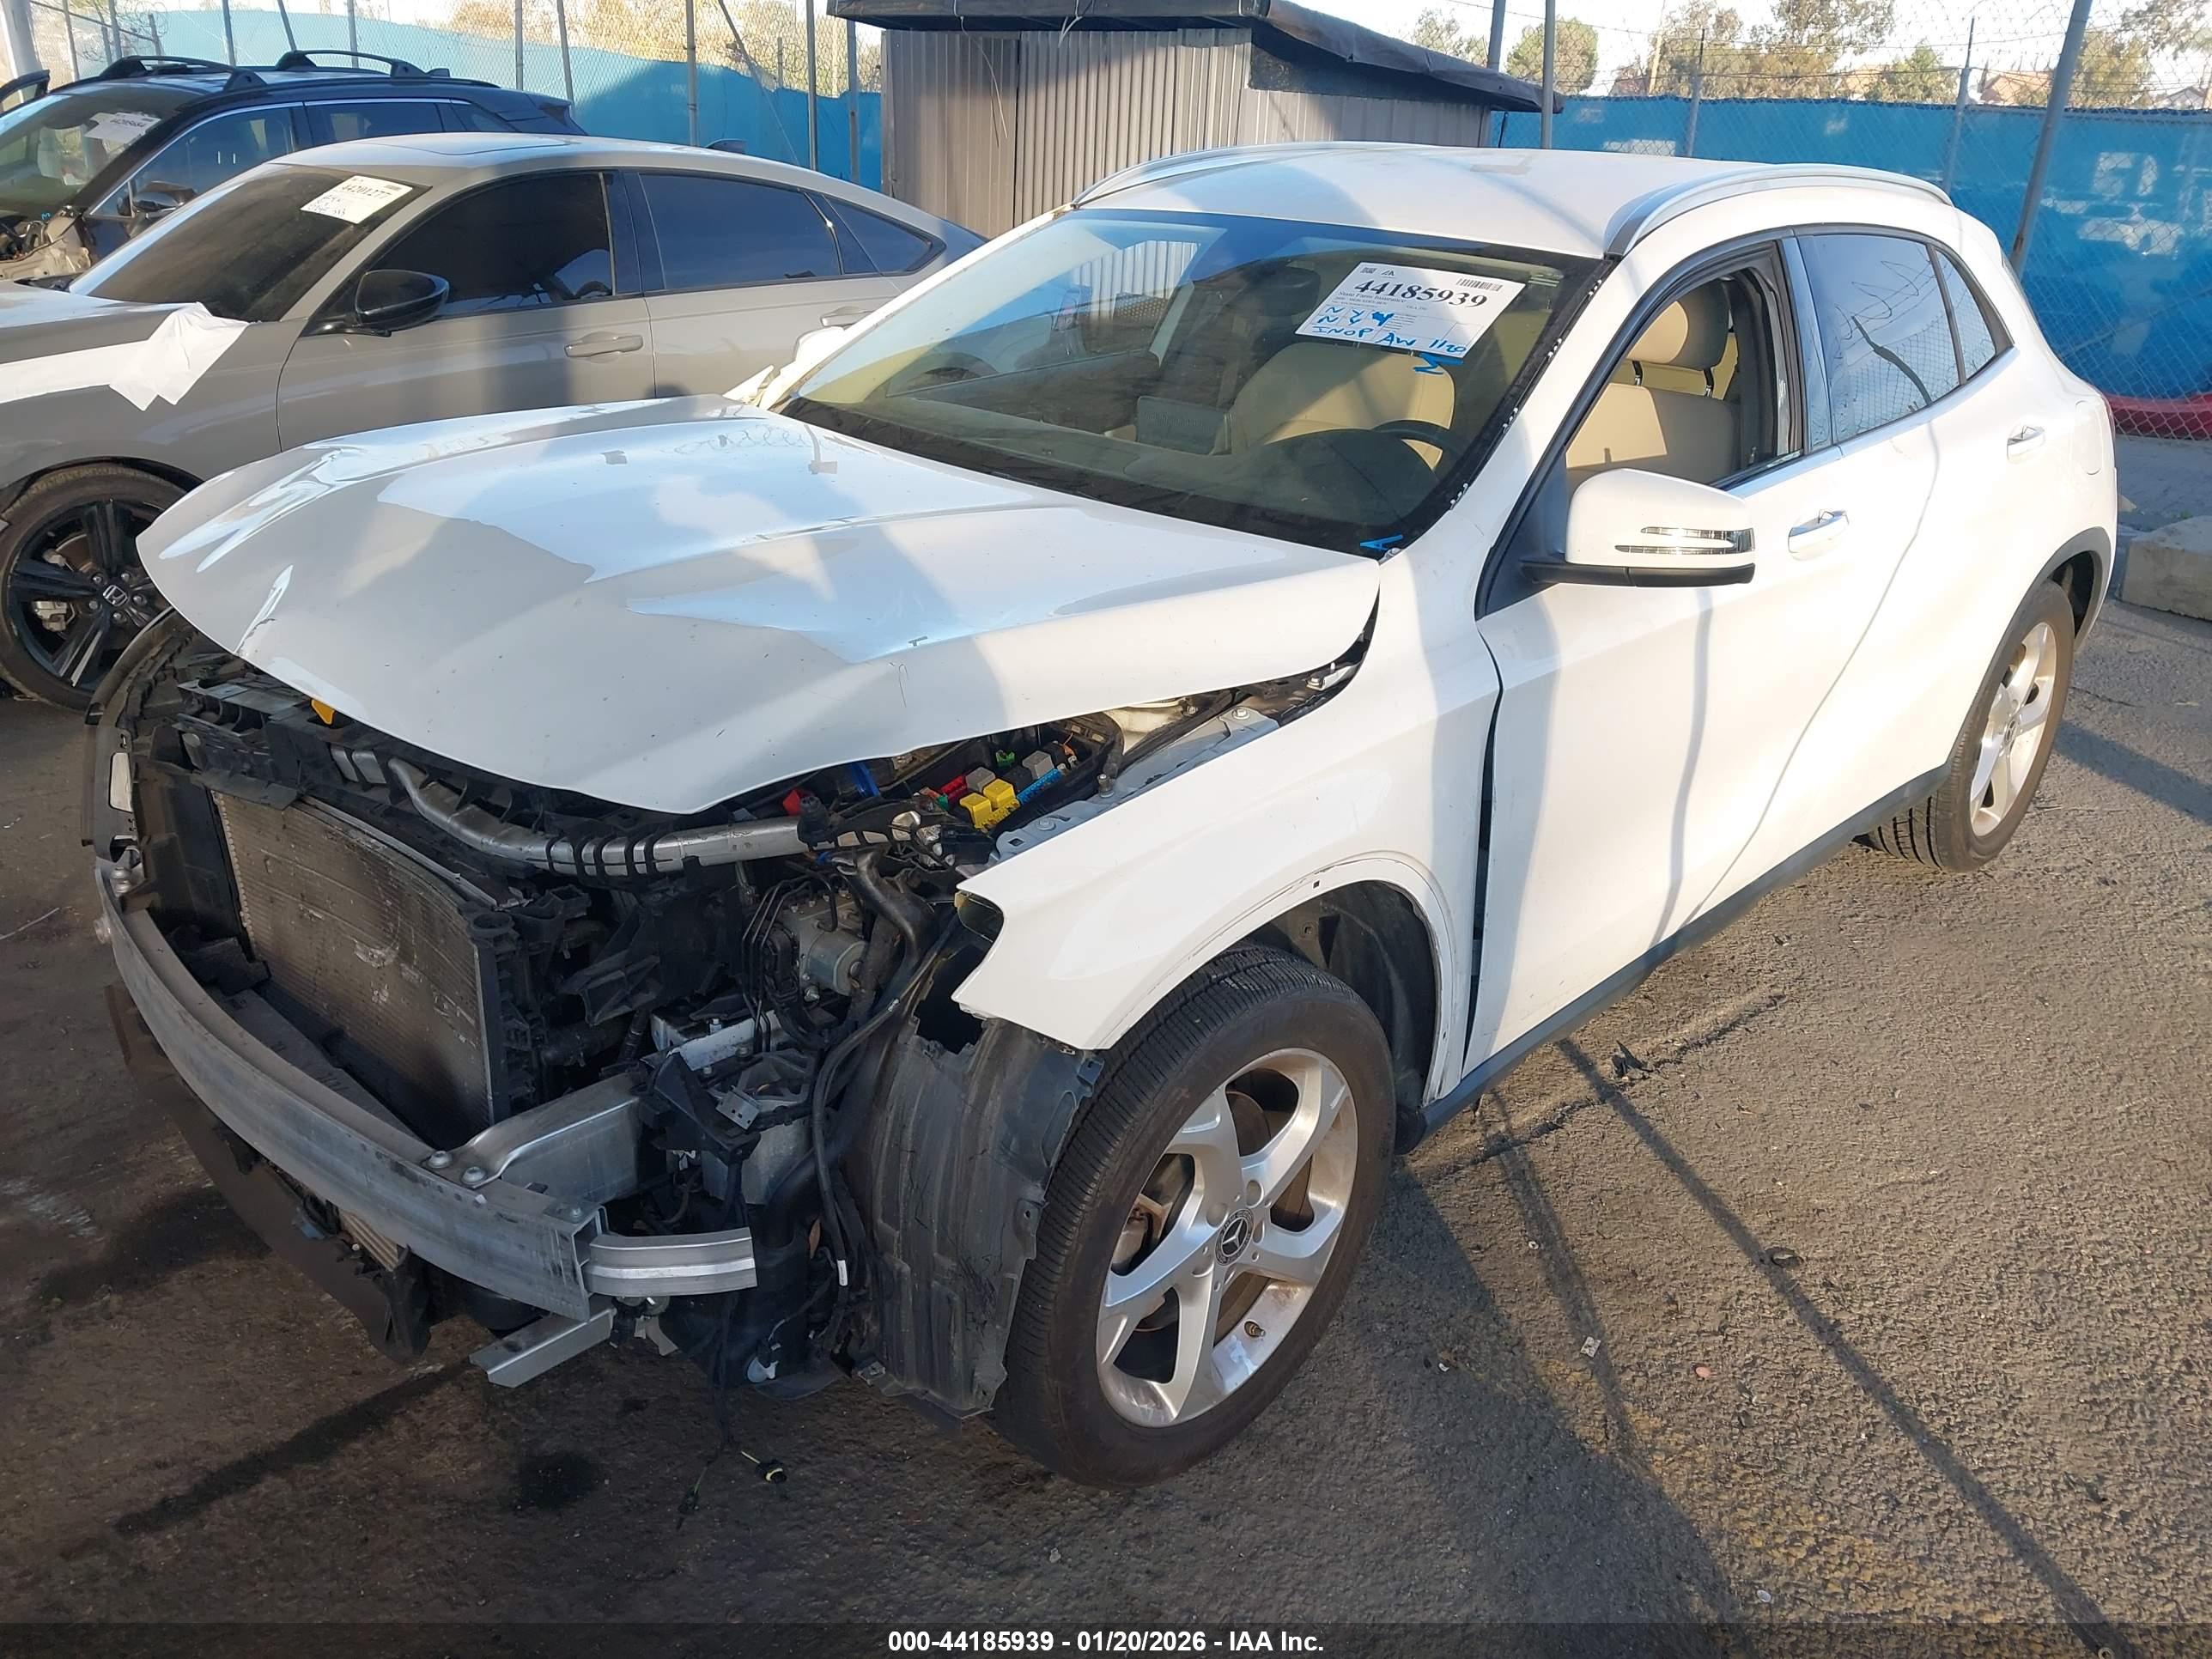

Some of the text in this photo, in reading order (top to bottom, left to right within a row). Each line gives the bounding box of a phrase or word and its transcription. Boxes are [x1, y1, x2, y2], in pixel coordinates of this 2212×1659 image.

[1354, 279, 1488, 308] 44185939
[1374, 295, 1407, 303] Insurance
[1311, 325, 1374, 338] INOP
